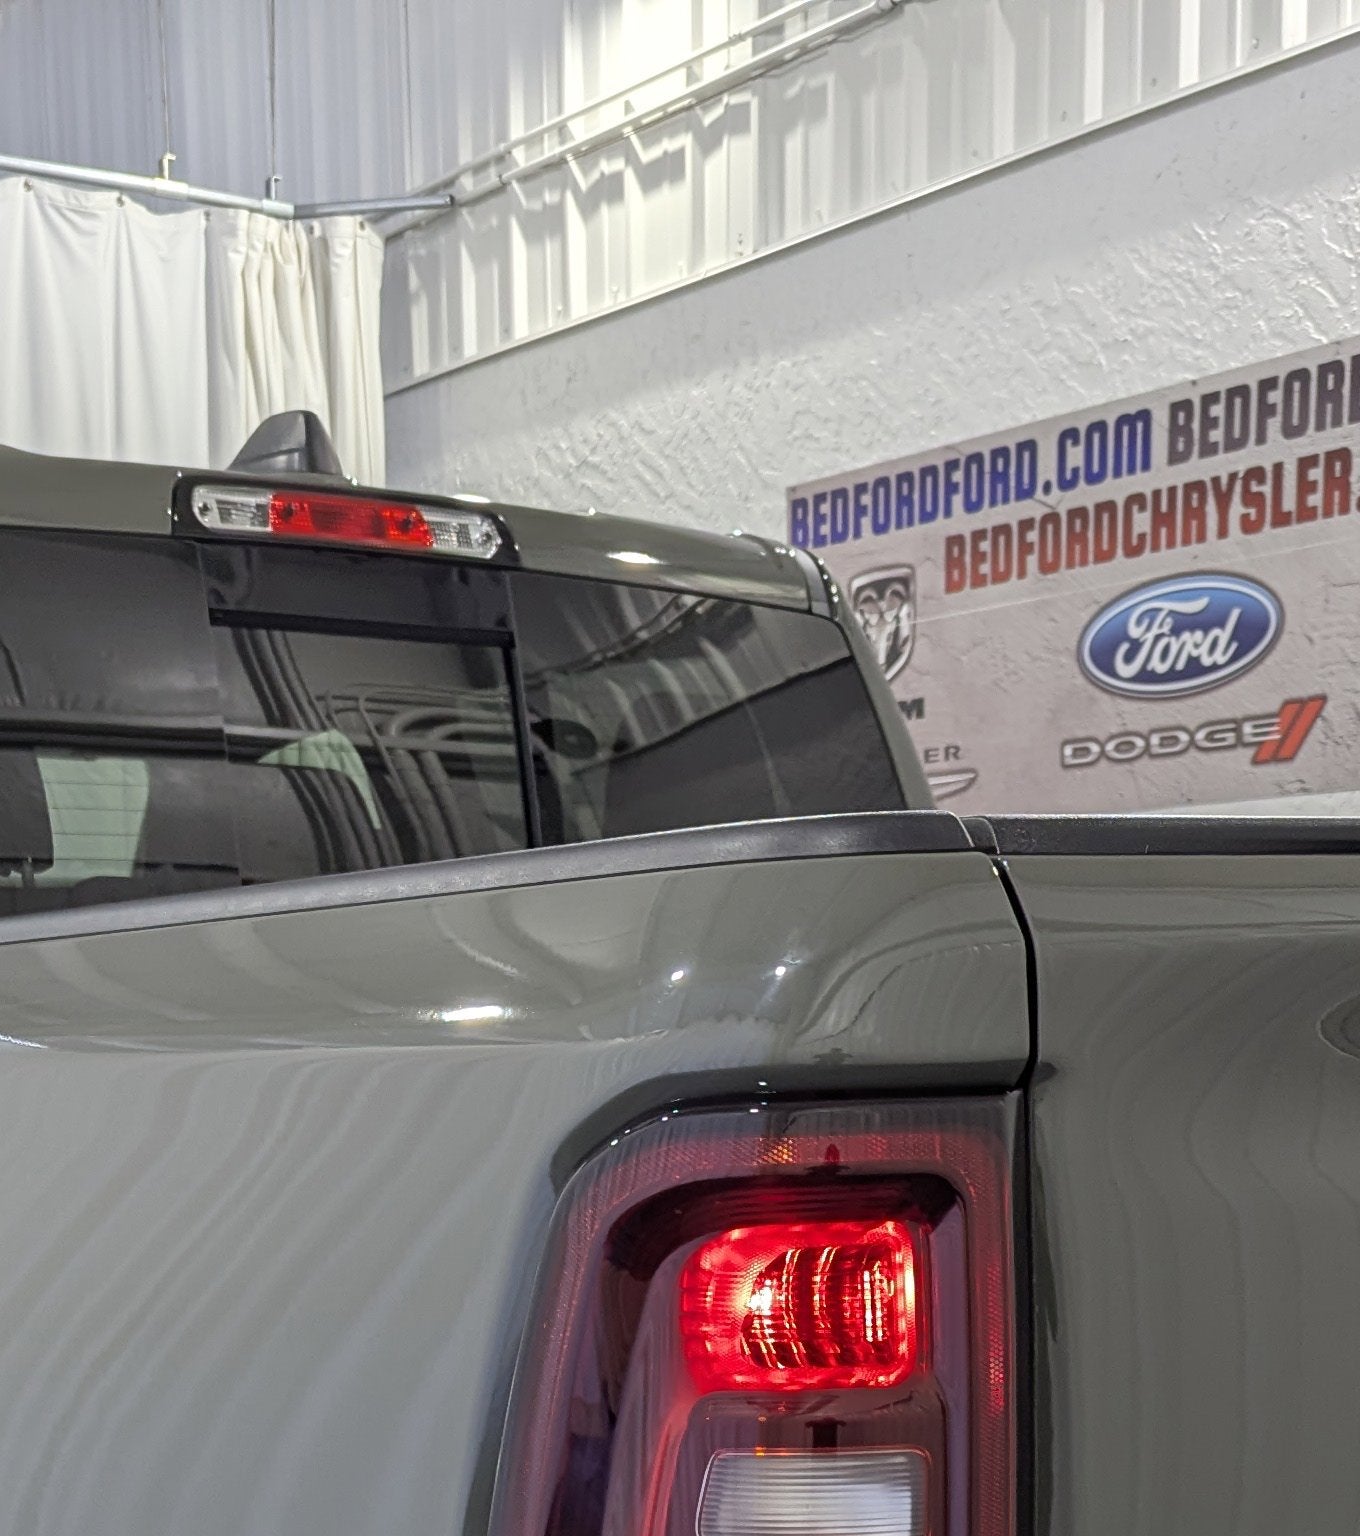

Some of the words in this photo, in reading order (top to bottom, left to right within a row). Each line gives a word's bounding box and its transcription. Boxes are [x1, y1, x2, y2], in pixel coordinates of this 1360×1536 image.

[791, 408, 1153, 551] BEDFORDFORD.COM
[1114, 596, 1244, 679] Ford
[1061, 712, 1284, 768] DODGE
